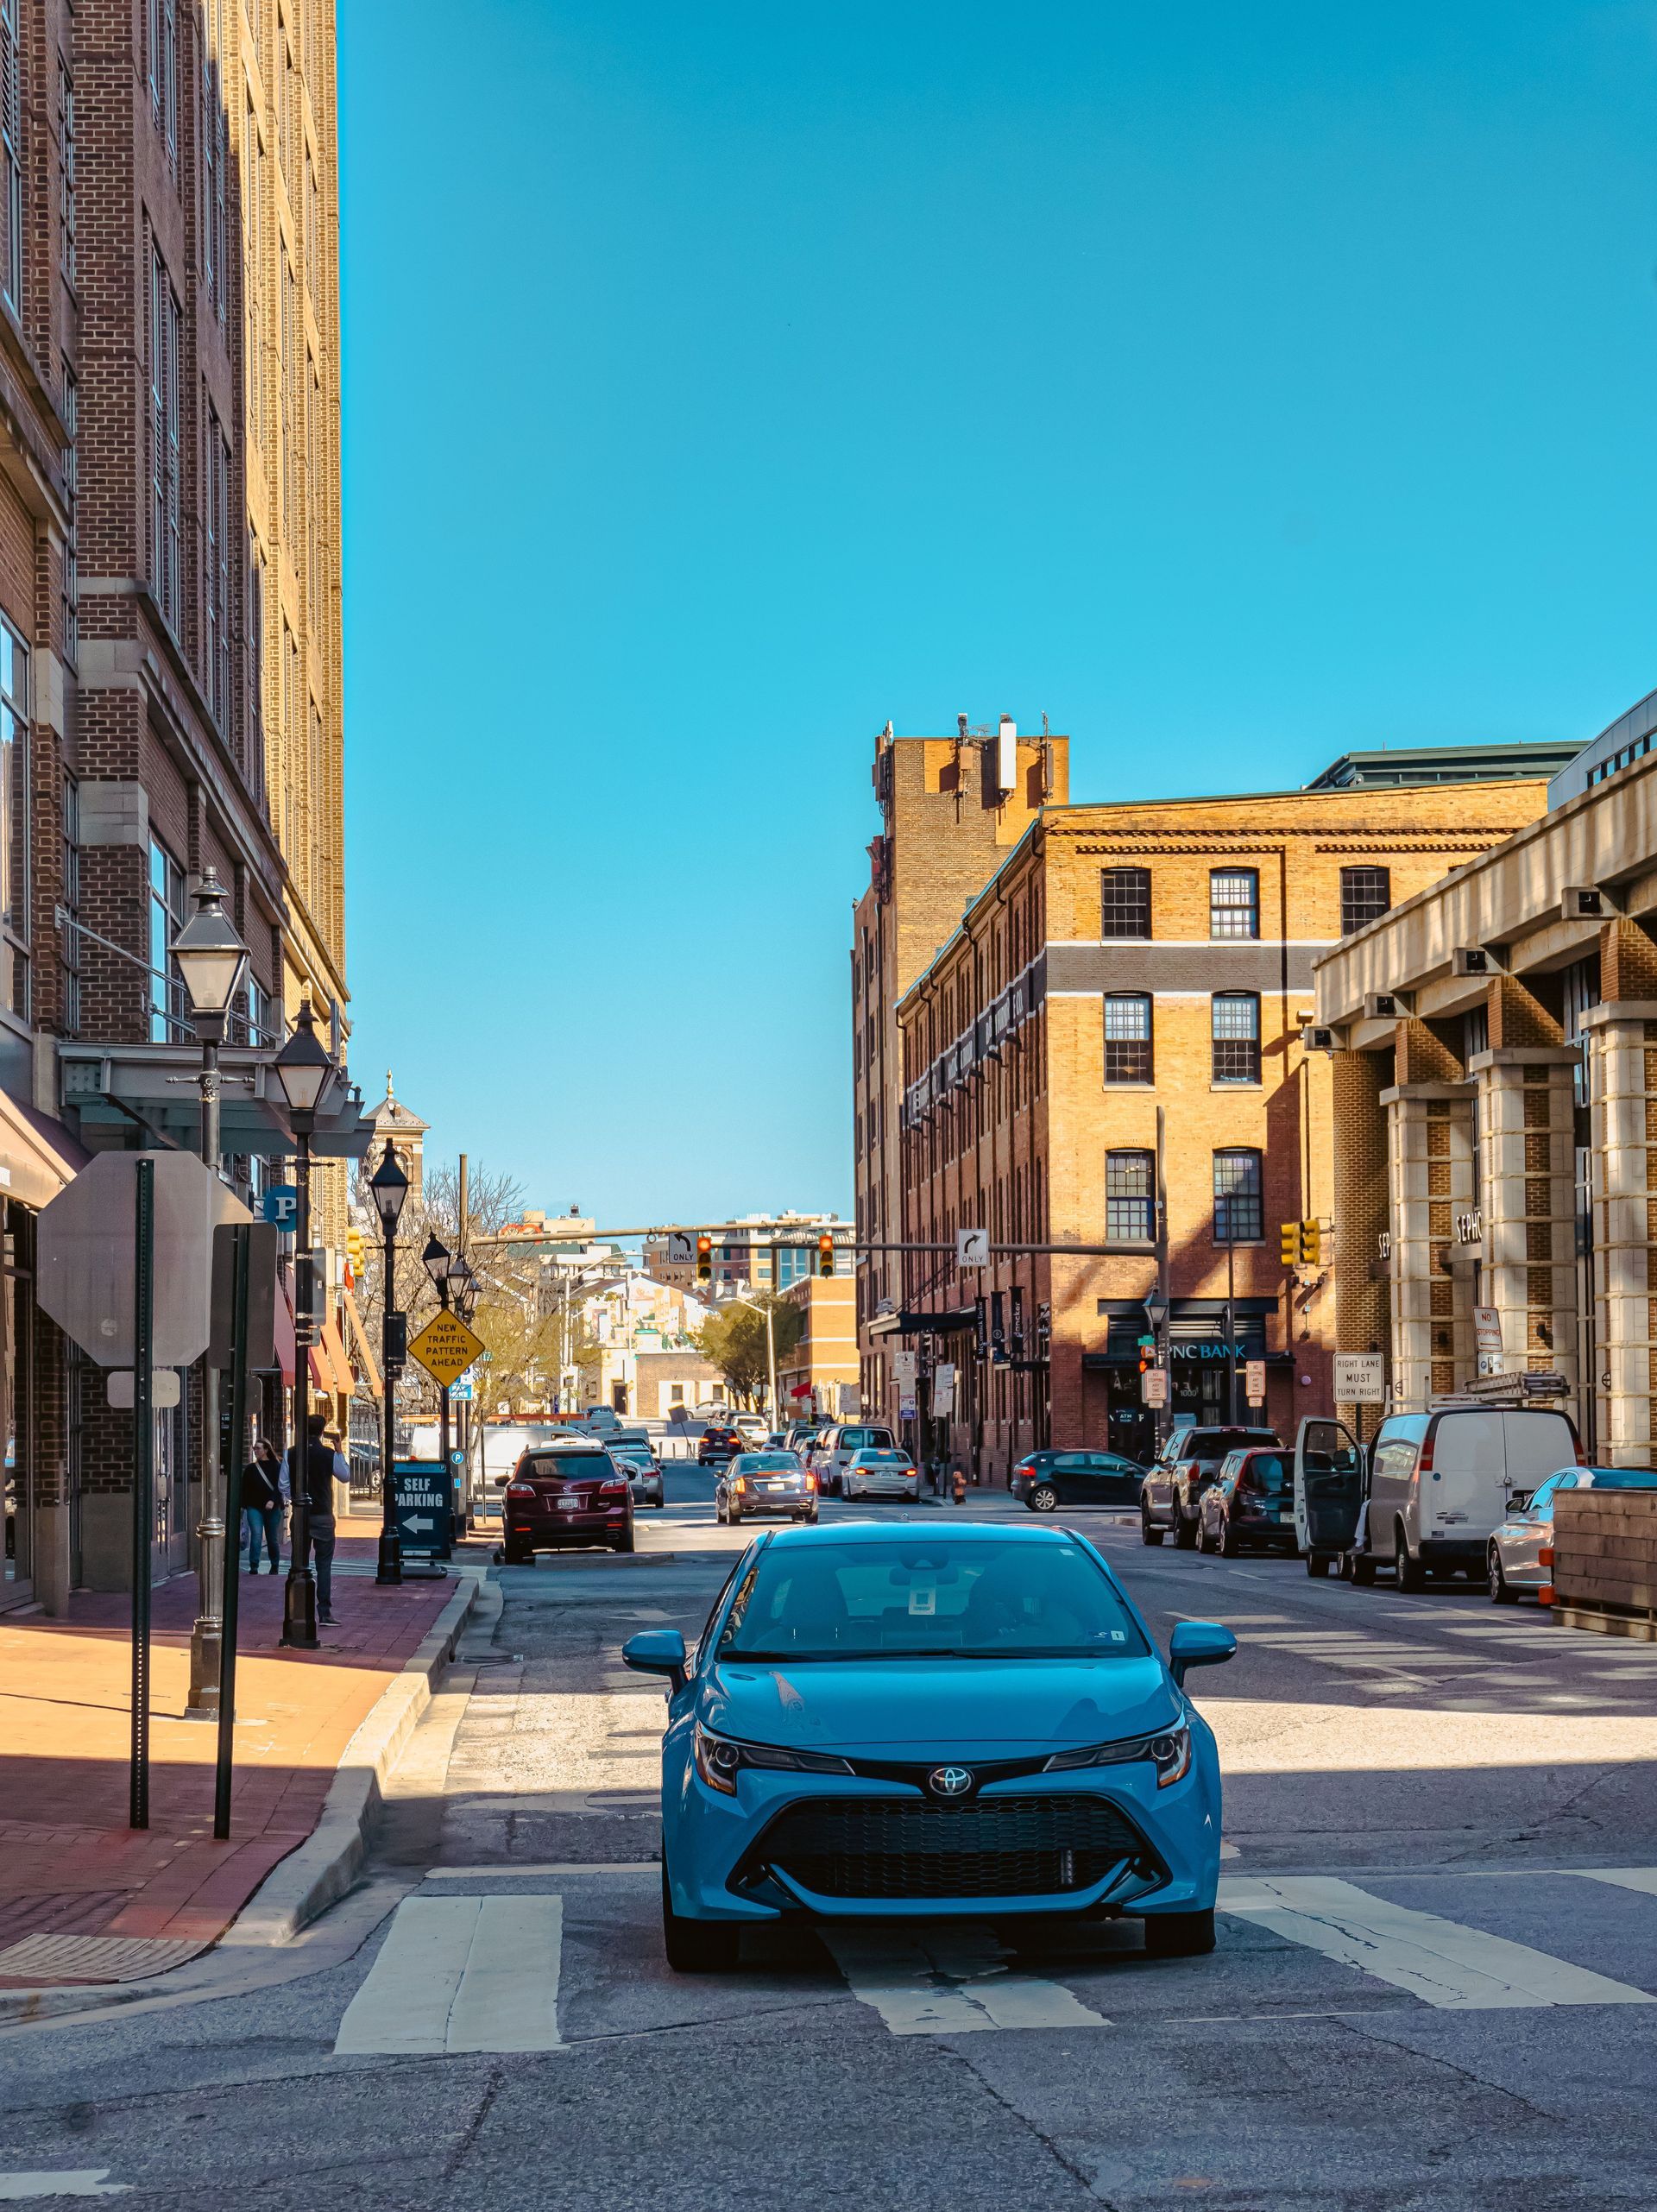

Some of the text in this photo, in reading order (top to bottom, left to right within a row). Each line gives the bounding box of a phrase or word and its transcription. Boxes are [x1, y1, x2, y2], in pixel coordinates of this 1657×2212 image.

[275, 1196, 297, 1219] P
[1481, 1314, 1491, 1322] NO
[427, 1335, 466, 1344] TRAFFIC
[425, 1346, 468, 1355] PATTERN
[431, 1358, 463, 1367] AHEAD
[1346, 1374, 1370, 1383] MUST
[404, 1478, 431, 1491] SELF
